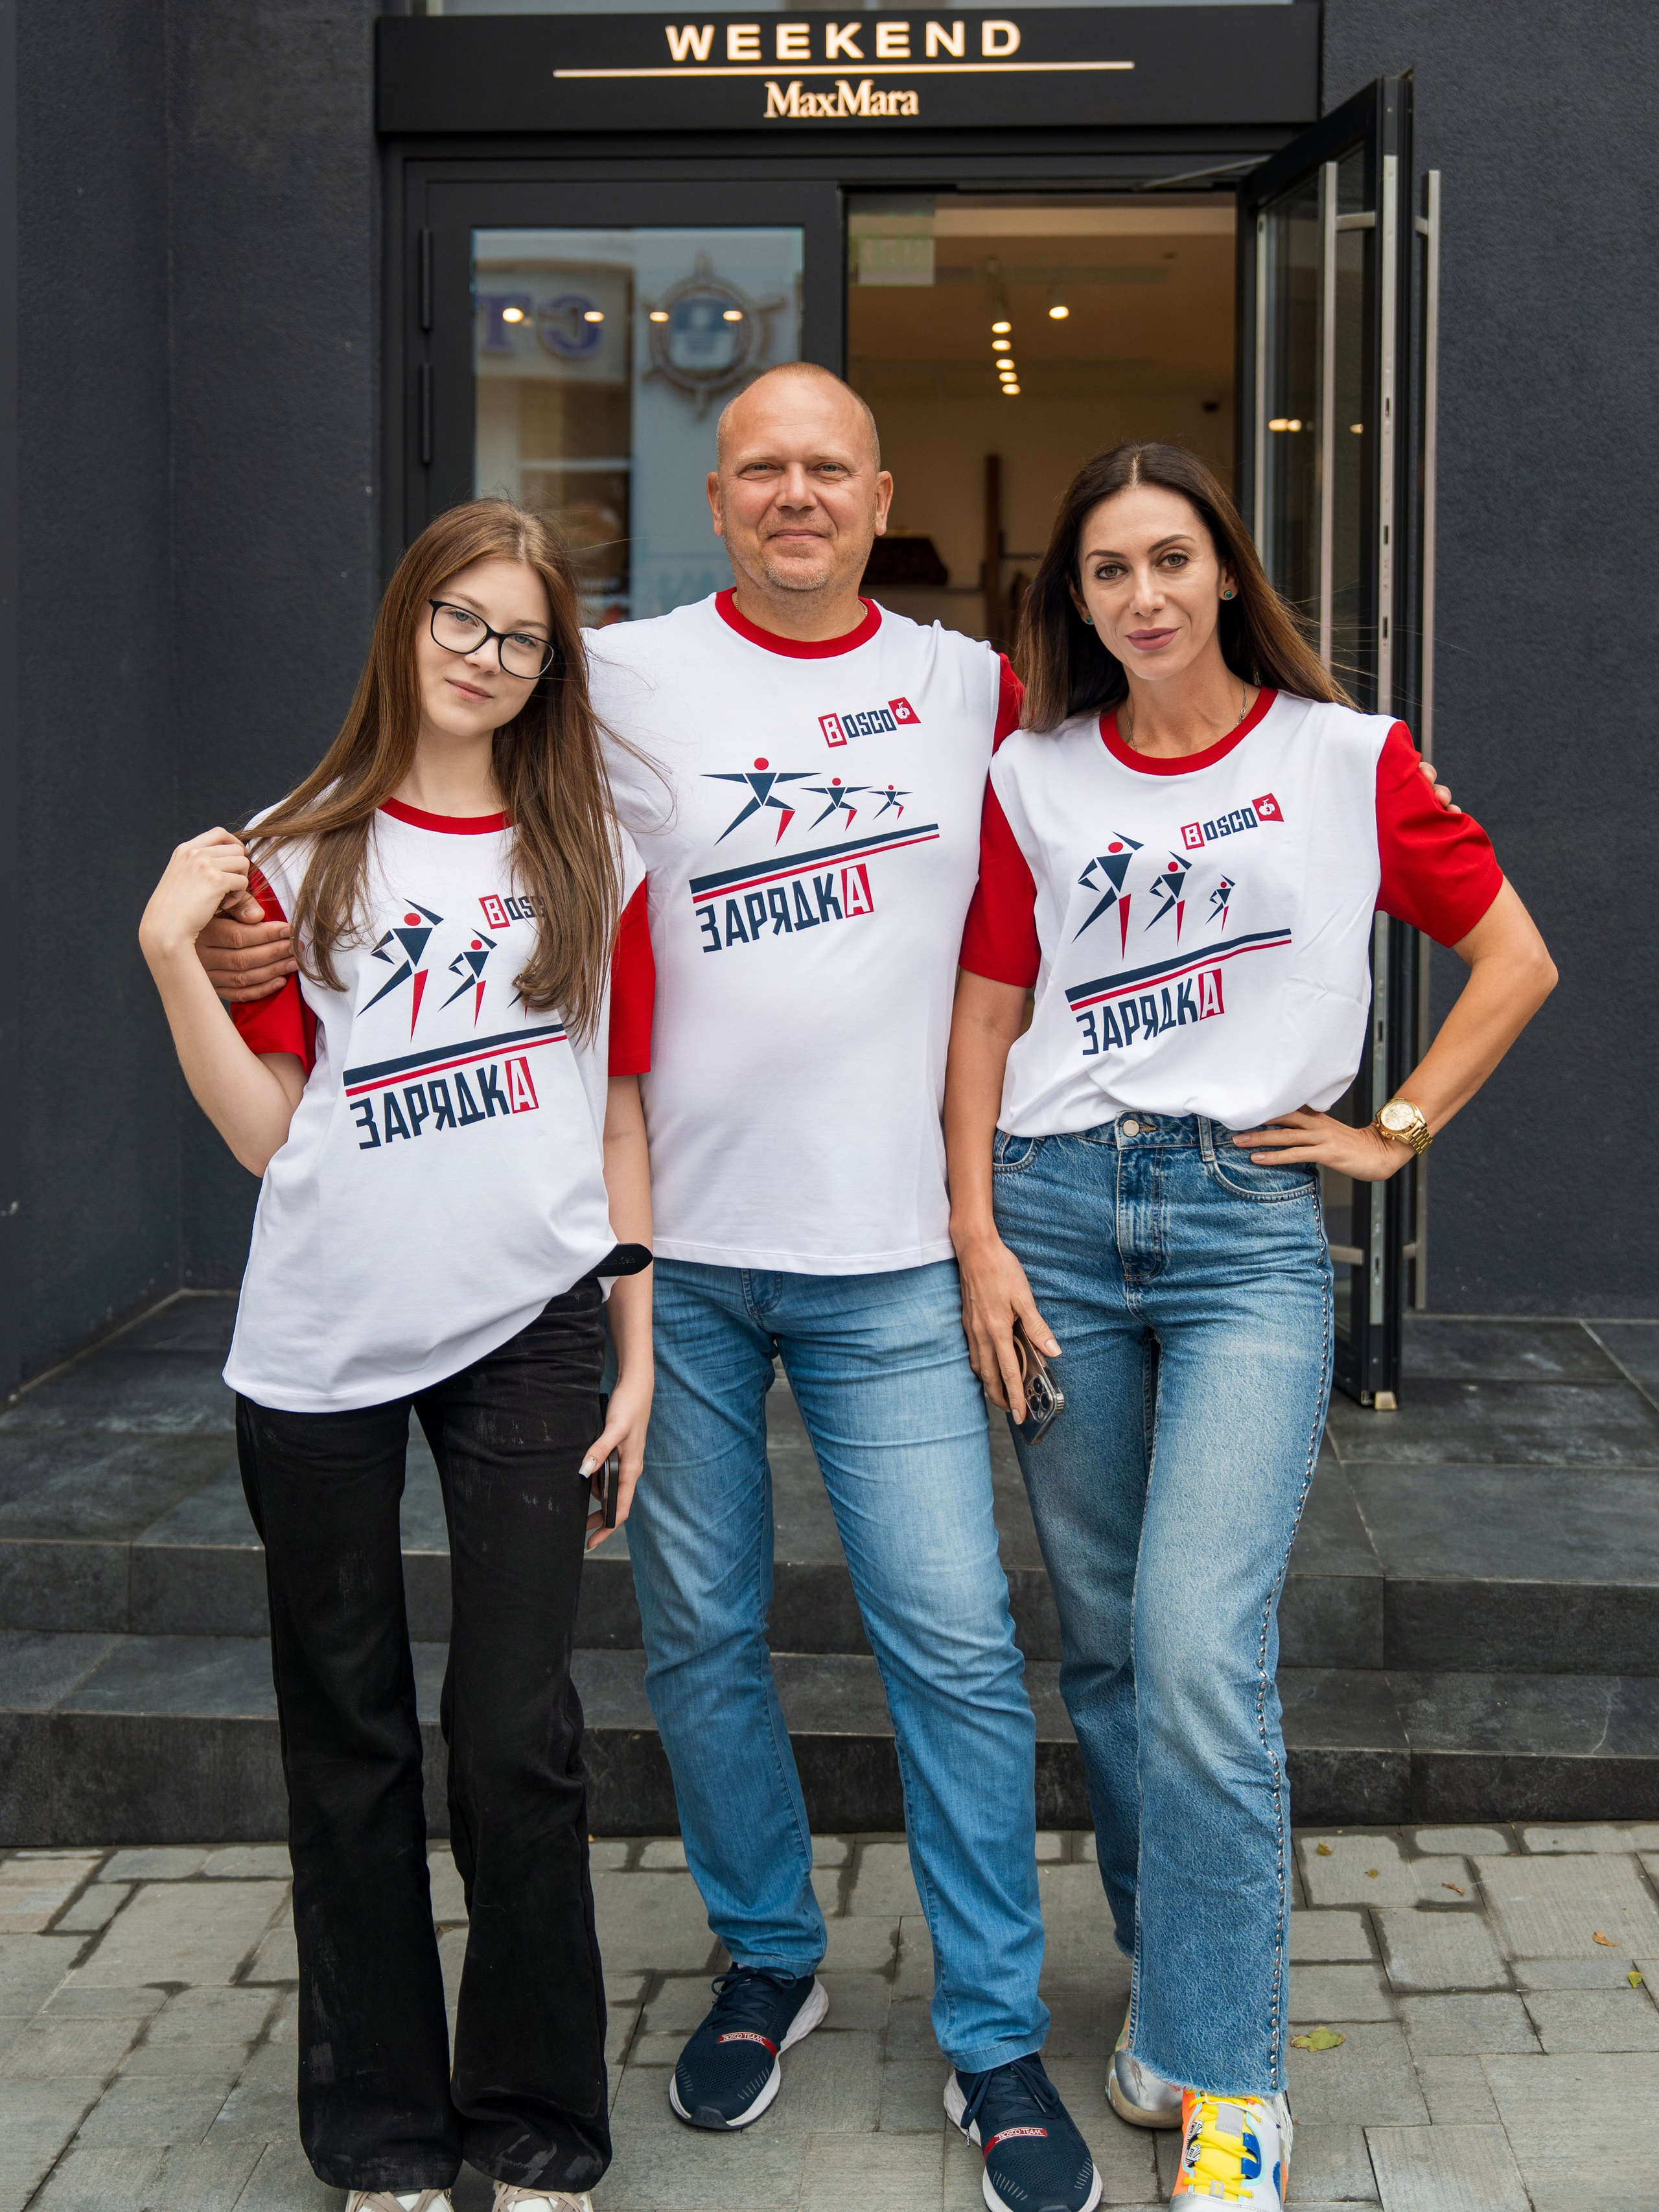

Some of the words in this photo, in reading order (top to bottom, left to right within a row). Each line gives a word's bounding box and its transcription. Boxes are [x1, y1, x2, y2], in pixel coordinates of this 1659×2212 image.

[665, 20, 1021, 61] WEEKEND
[763, 79, 919, 118] MaxMara
[478, 894, 544, 929] BOS
[696, 863, 874, 953] ЗАРЯДКА
[1076, 968, 1225, 1056] ЗАРЯДКА
[349, 1056, 539, 1150] ЗАРЯДКА
[743, 2033, 763, 2043] TEAM
[999, 2129, 1021, 2139] BOSCO
